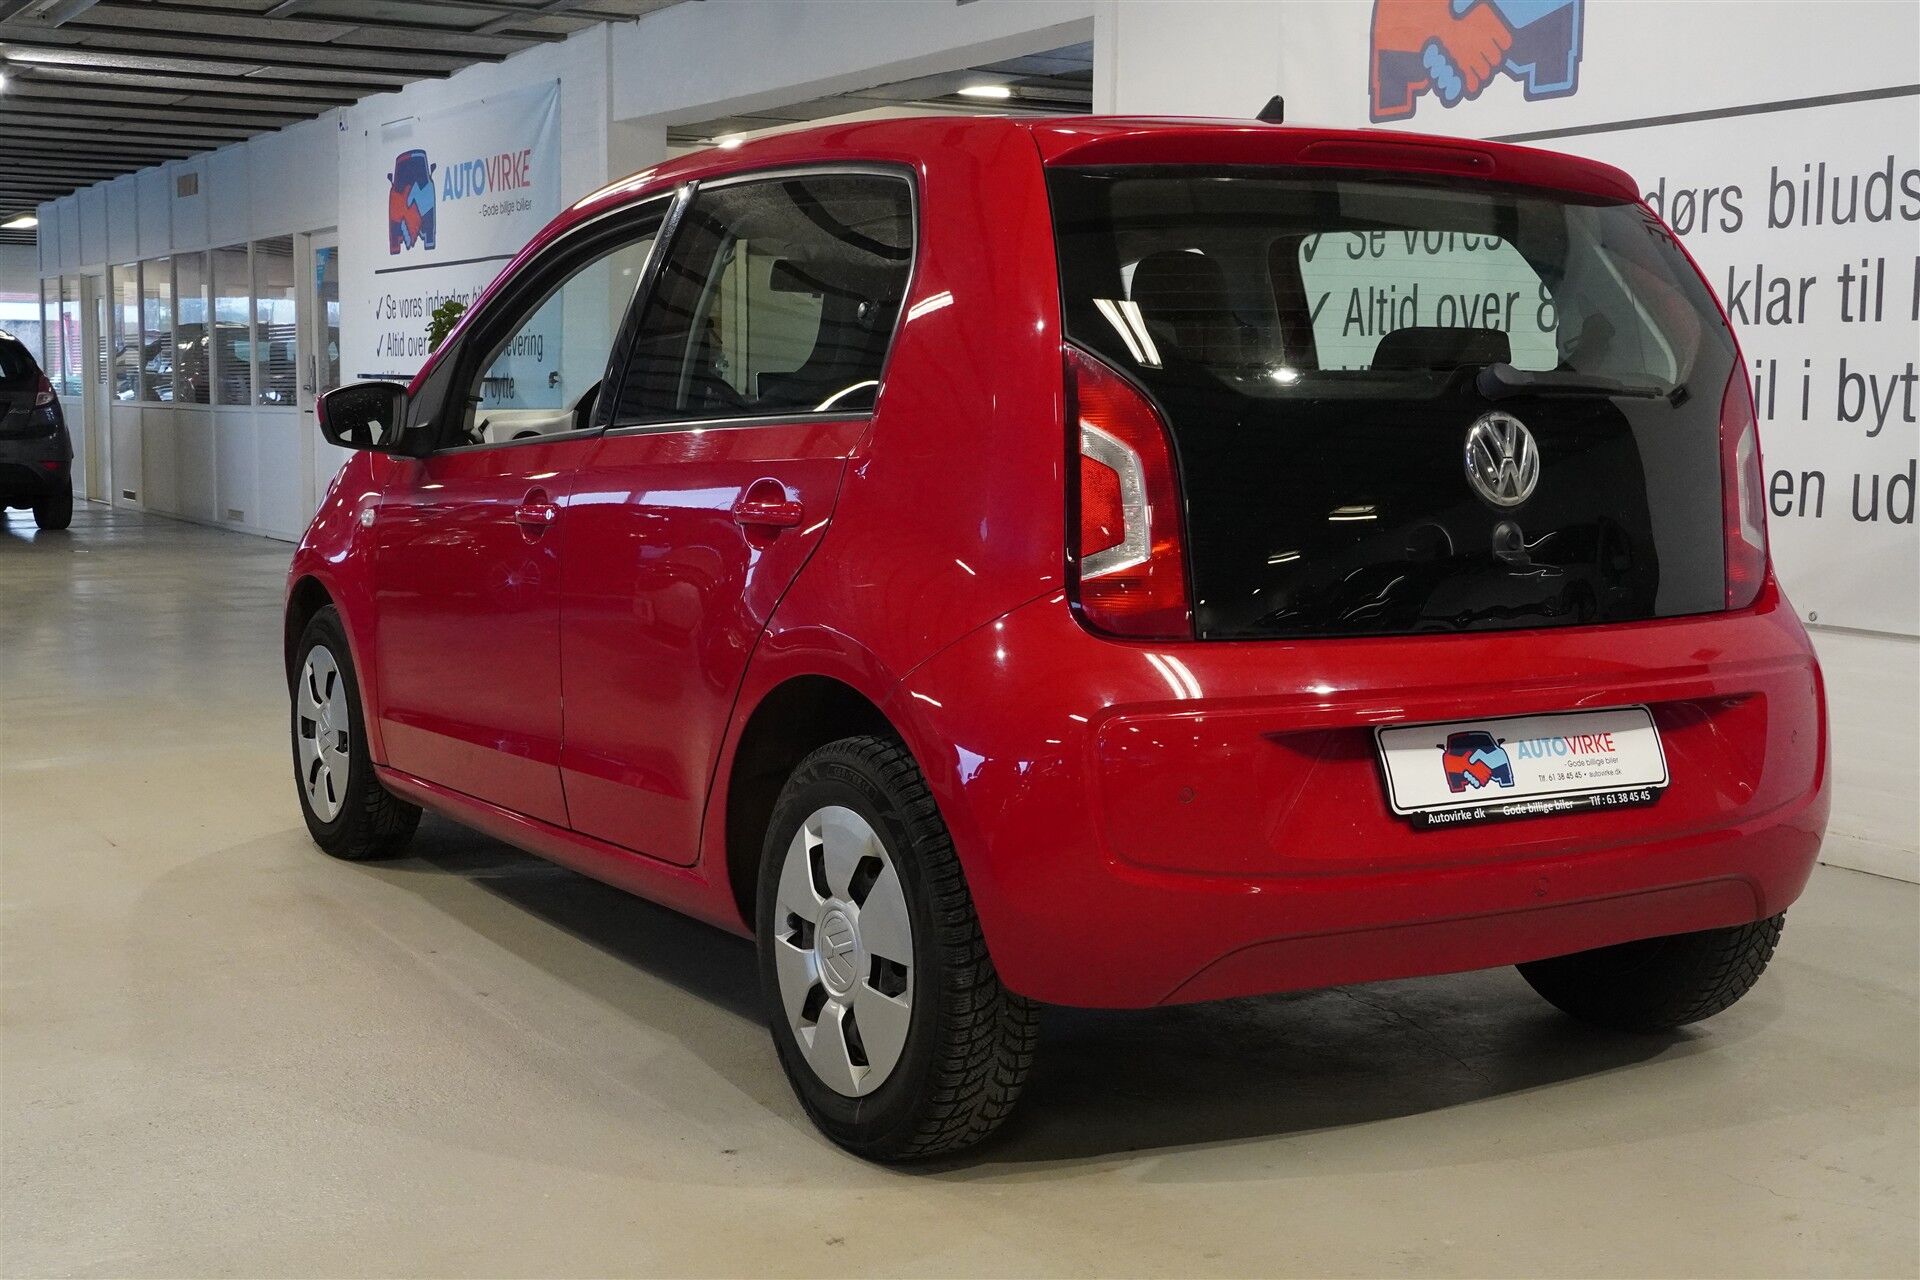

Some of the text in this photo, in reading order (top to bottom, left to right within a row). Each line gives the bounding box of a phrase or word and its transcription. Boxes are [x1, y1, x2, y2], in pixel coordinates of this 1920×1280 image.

[442, 149, 531, 201] AUTOVIRKE
[386, 294, 396, 319] Se
[400, 297, 422, 318] vores
[1342, 283, 1419, 337] Altid
[1436, 291, 1520, 333] over
[1727, 264, 1817, 326] klar
[1838, 257, 1885, 323] til
[386, 332, 427, 357] Altid over
[1801, 358, 1811, 421] i
[1518, 733, 1616, 760] AUTOVIRKE
[1428, 809, 1472, 824] Autovirke
[1474, 807, 1486, 818] dk
[1503, 804, 1526, 816] Gode
[1528, 800, 1554, 813] billige
[1554, 799, 1574, 810] biler
[1606, 795, 1617, 804] 61
[1618, 793, 1628, 803] 38
[1629, 792, 1639, 802] 45
[1640, 791, 1651, 801] 45
